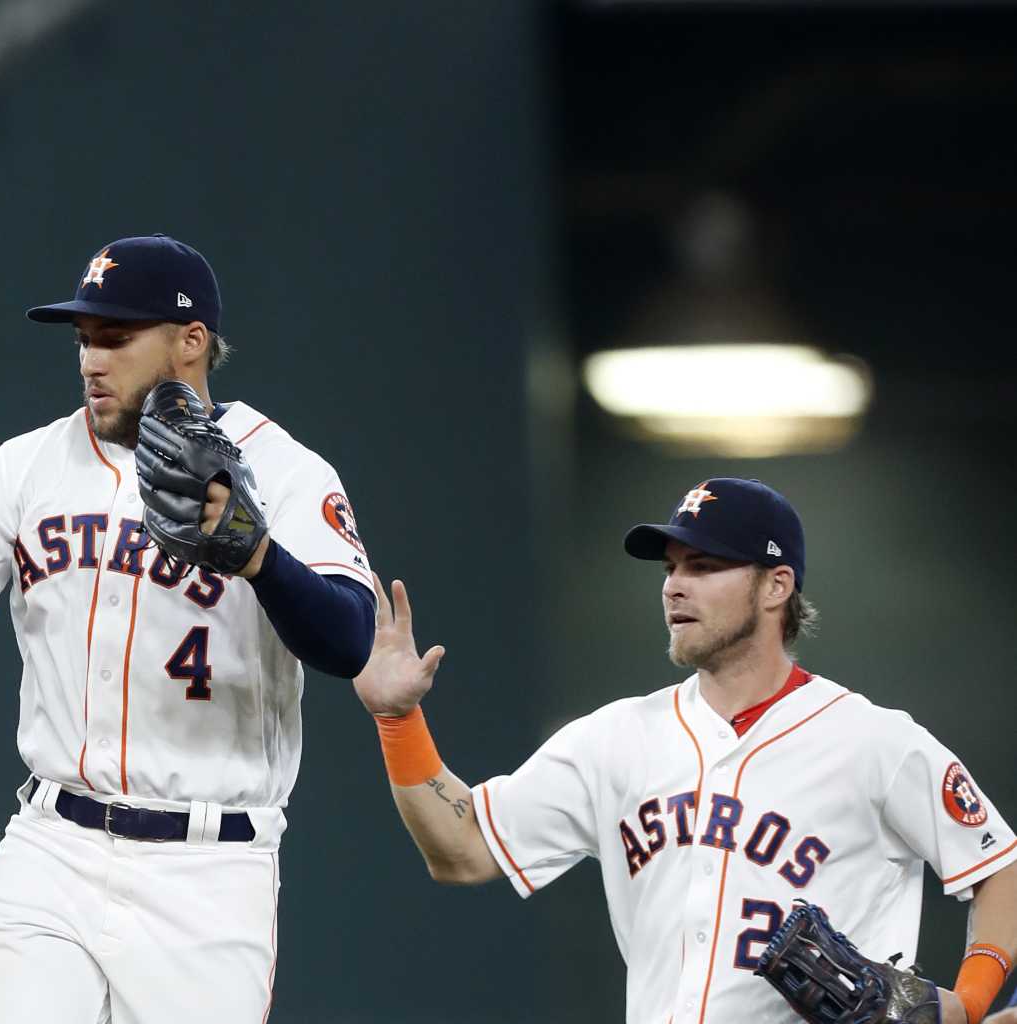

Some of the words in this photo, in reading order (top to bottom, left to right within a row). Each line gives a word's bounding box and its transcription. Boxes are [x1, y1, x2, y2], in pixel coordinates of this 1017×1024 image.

[83, 258, 112, 283] H
[164, 625, 212, 701] 4
[618, 790, 831, 889] ASTROS
